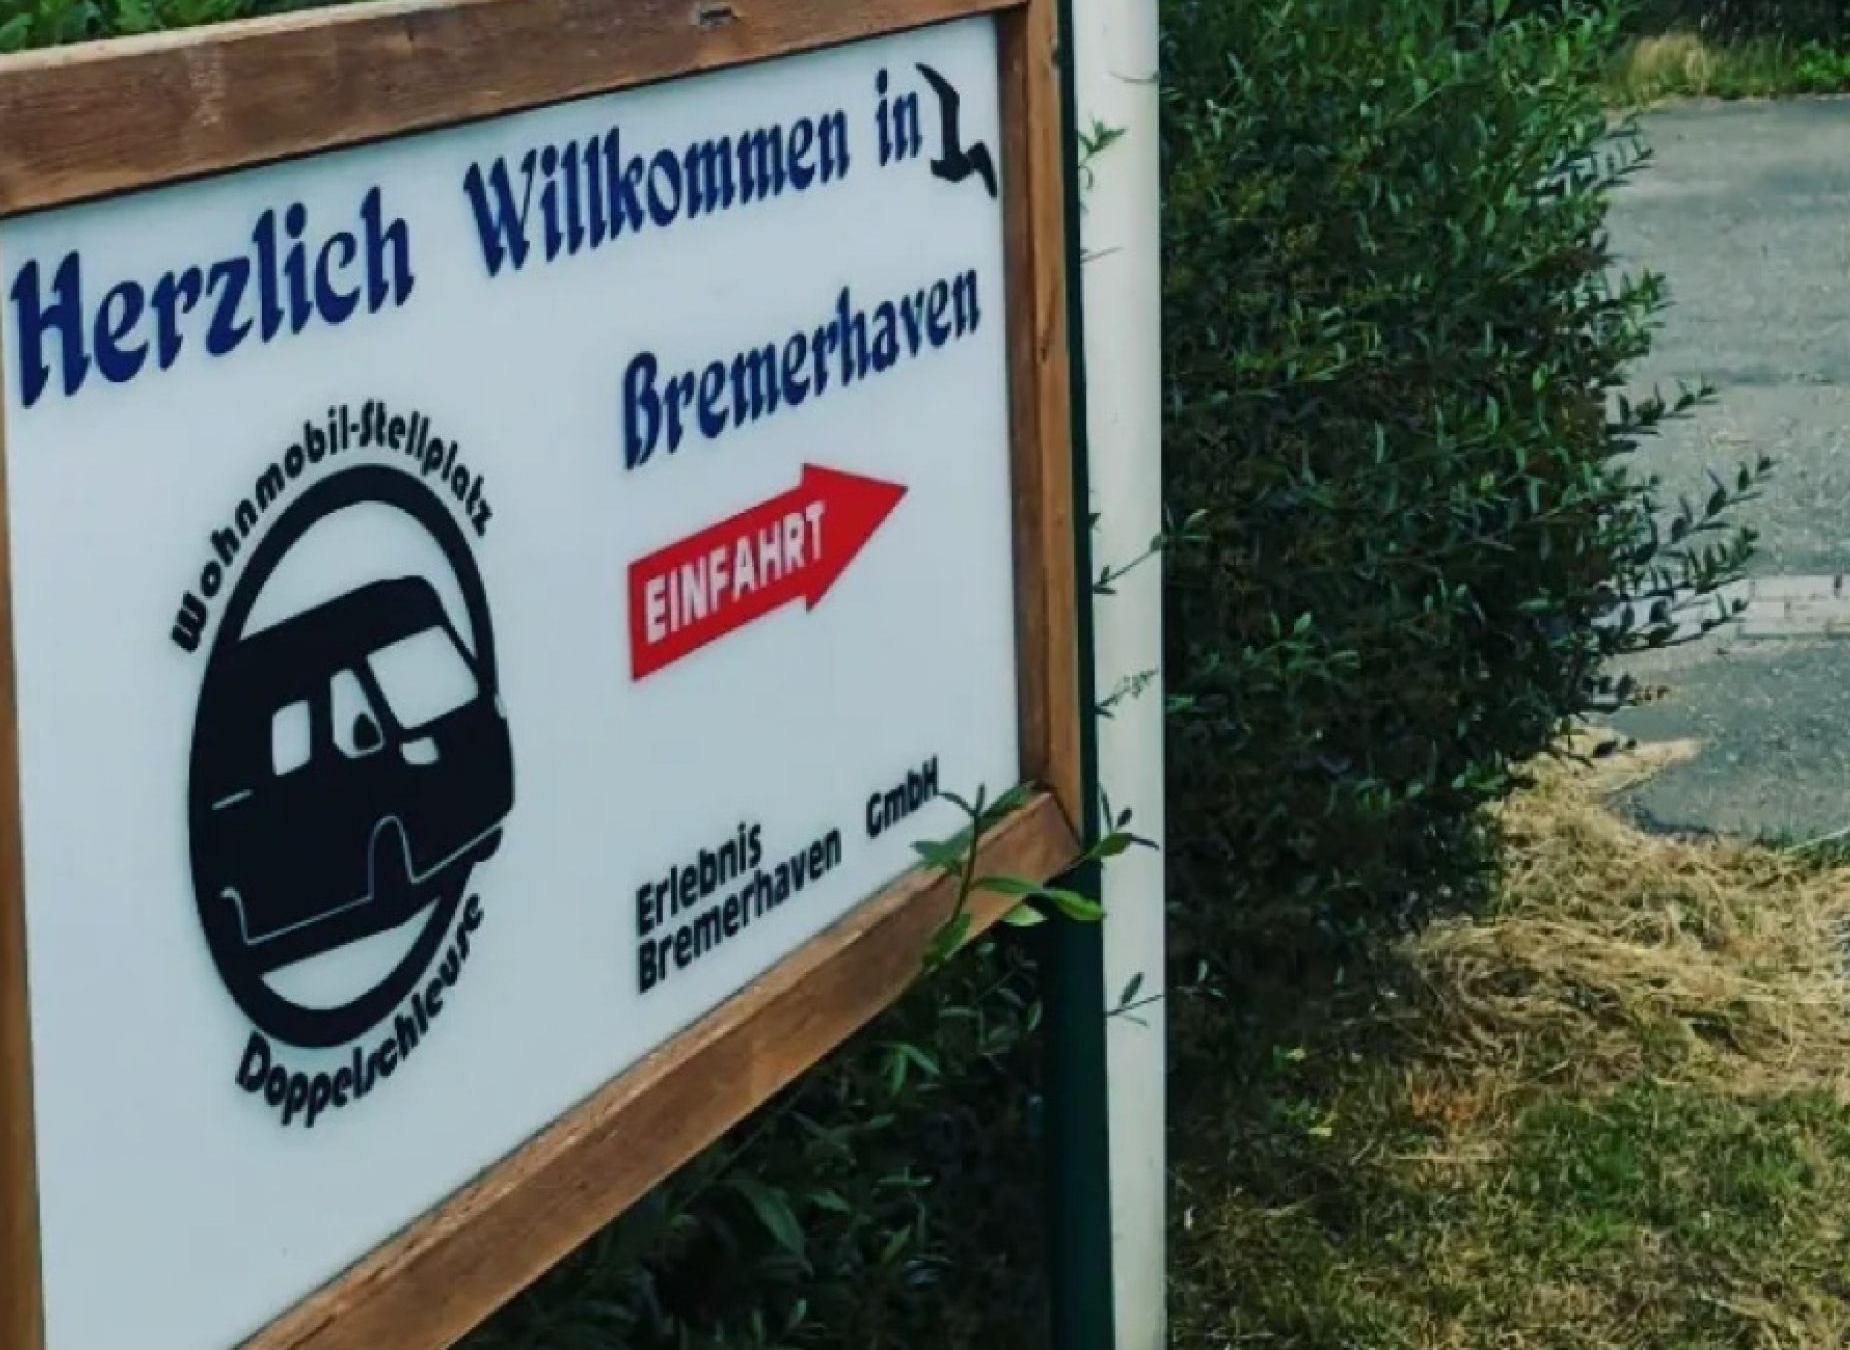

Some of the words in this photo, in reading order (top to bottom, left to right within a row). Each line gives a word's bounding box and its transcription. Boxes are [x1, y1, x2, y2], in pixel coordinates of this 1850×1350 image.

[10, 186, 415, 408] Herzlich
[463, 108, 850, 276] Willkommen
[875, 68, 922, 166] in
[624, 269, 980, 469] Bremerhaven
[645, 500, 825, 644] EINFAHRT
[636, 821, 762, 937] Erlebnis
[637, 828, 842, 994] Bremerhaven
[866, 754, 938, 838] GmbH
[235, 893, 484, 1128] Doppelschleuse
